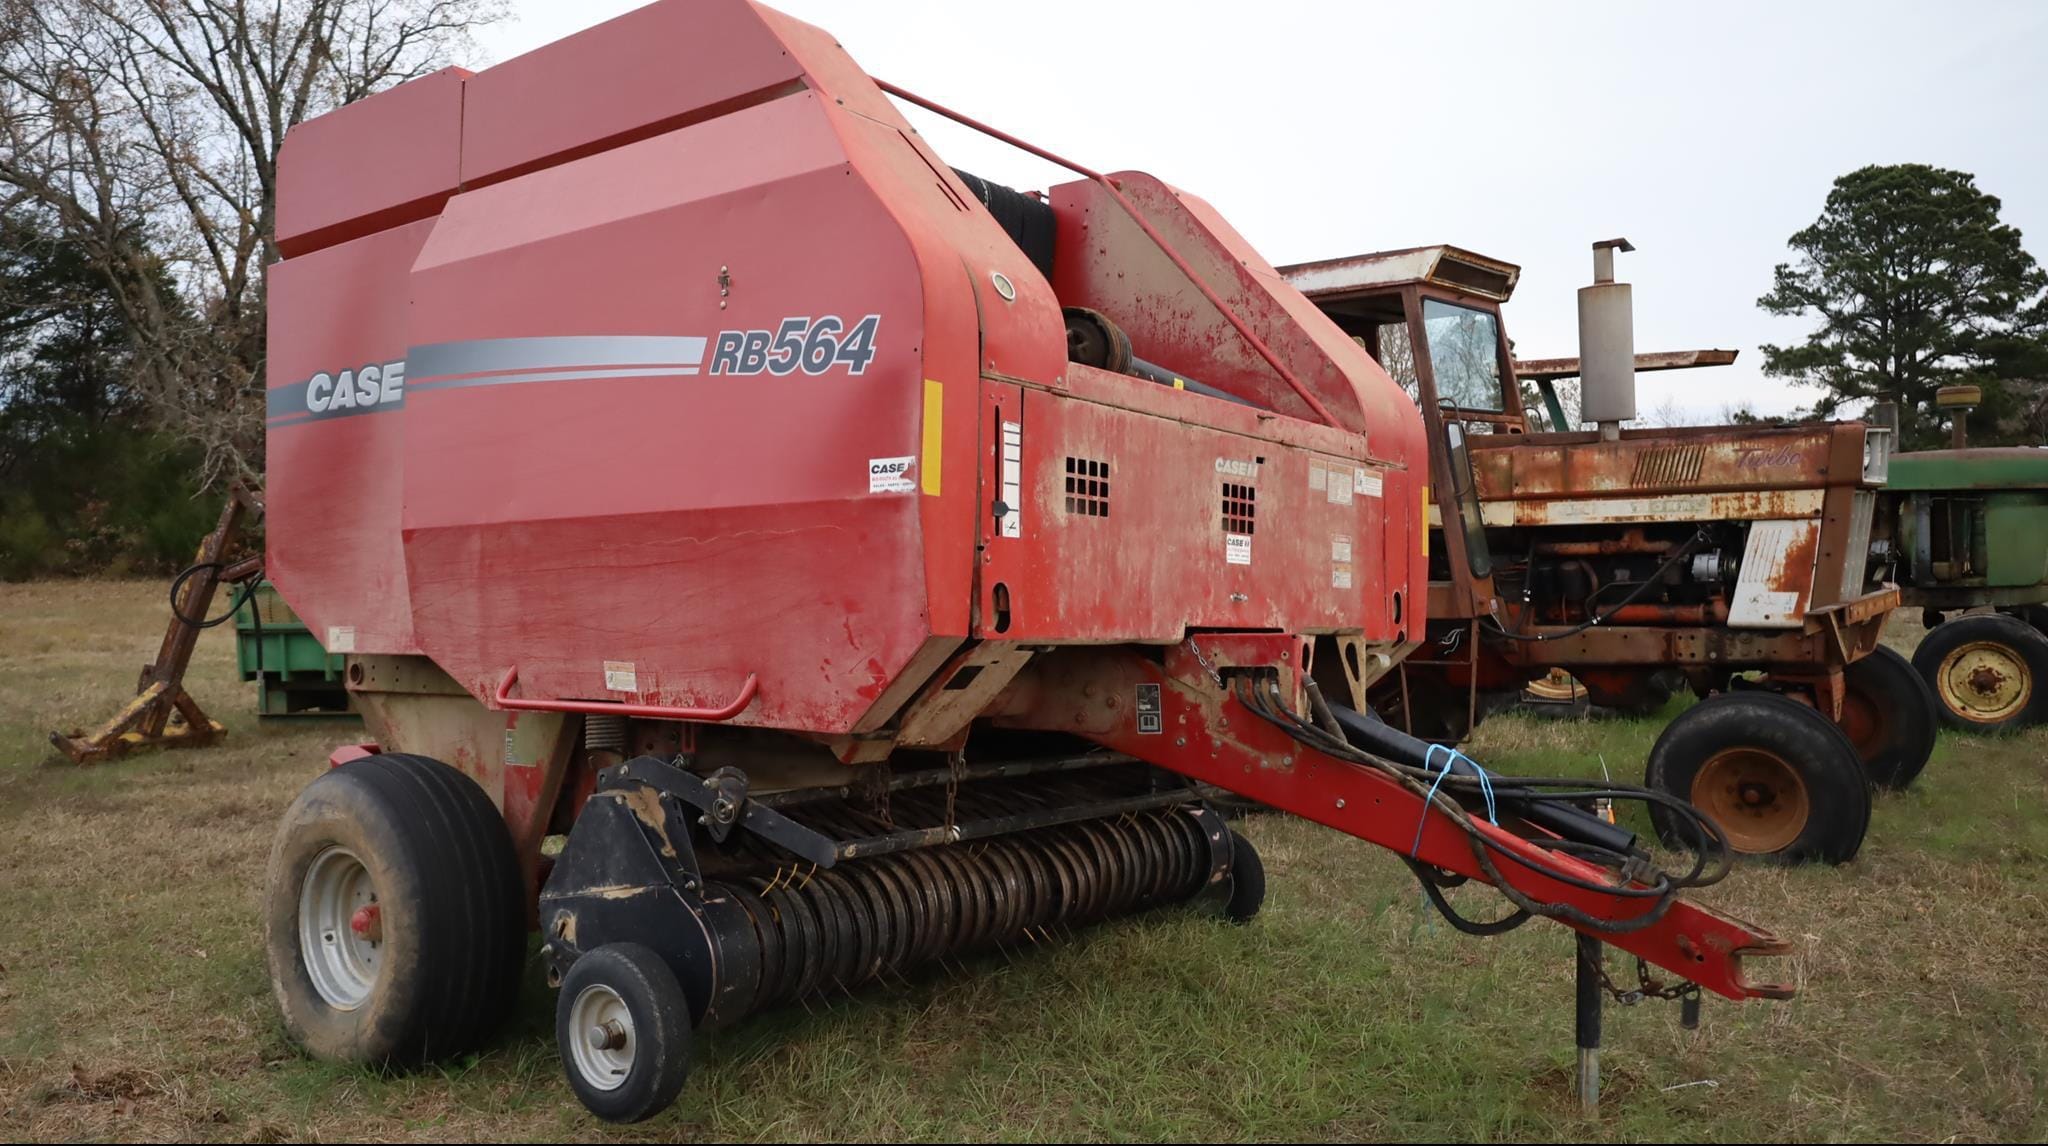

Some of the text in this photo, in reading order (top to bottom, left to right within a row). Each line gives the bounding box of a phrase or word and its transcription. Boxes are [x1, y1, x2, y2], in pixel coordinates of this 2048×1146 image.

[709, 314, 882, 376] RB564
[306, 361, 405, 413] CASE
[1215, 456, 1248, 476] CASE
[1732, 444, 1802, 469] Turbo
[871, 462, 905, 474] CASE
[1227, 538, 1244, 547] CASE
